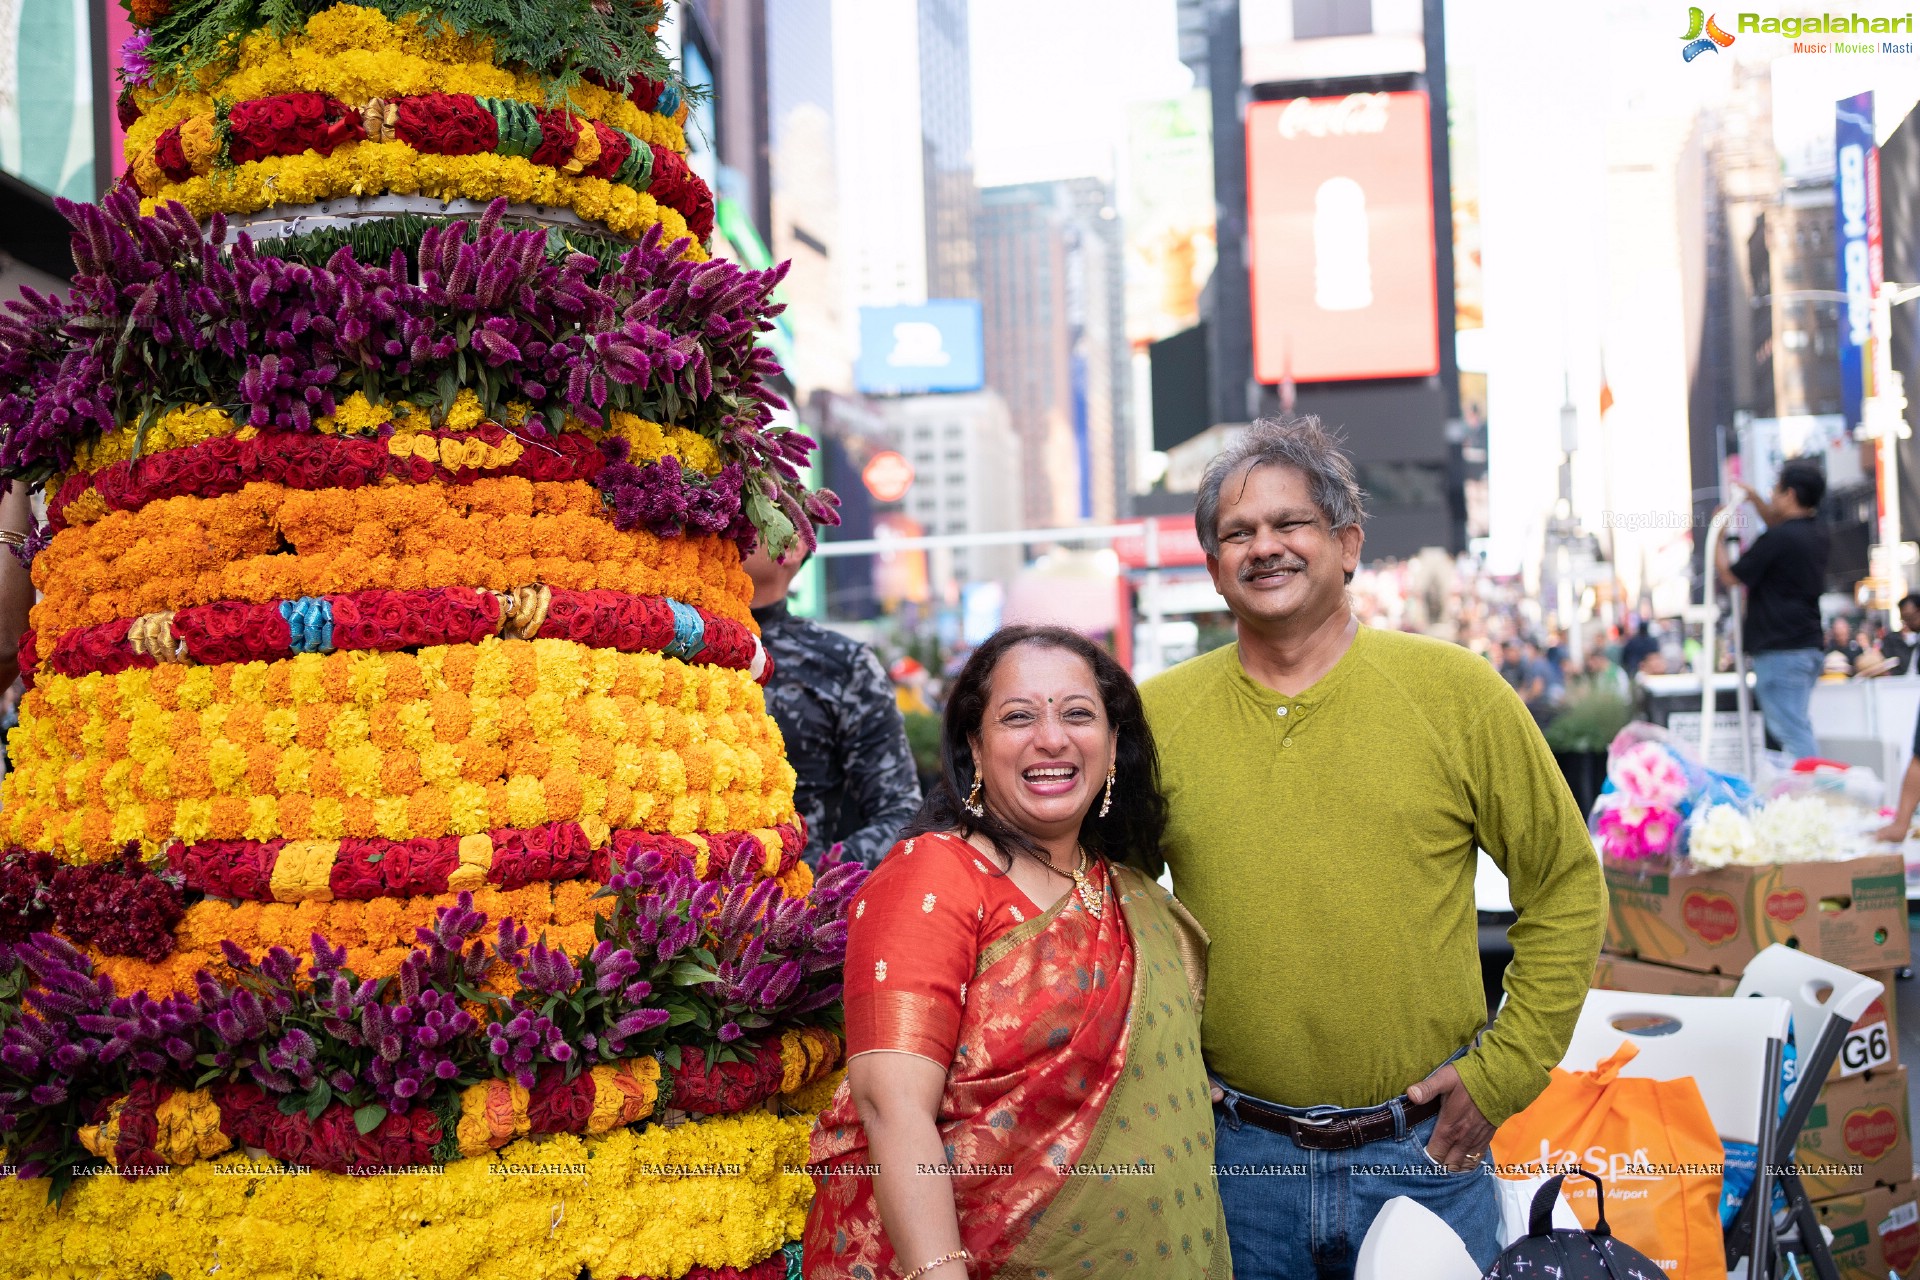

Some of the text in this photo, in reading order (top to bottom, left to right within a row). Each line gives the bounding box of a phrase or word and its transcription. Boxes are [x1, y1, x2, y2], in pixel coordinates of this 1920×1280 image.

[1842, 1028, 1887, 1069] G6
[1586, 1188, 1604, 1198] th
[1607, 1188, 1649, 1200] Airport
